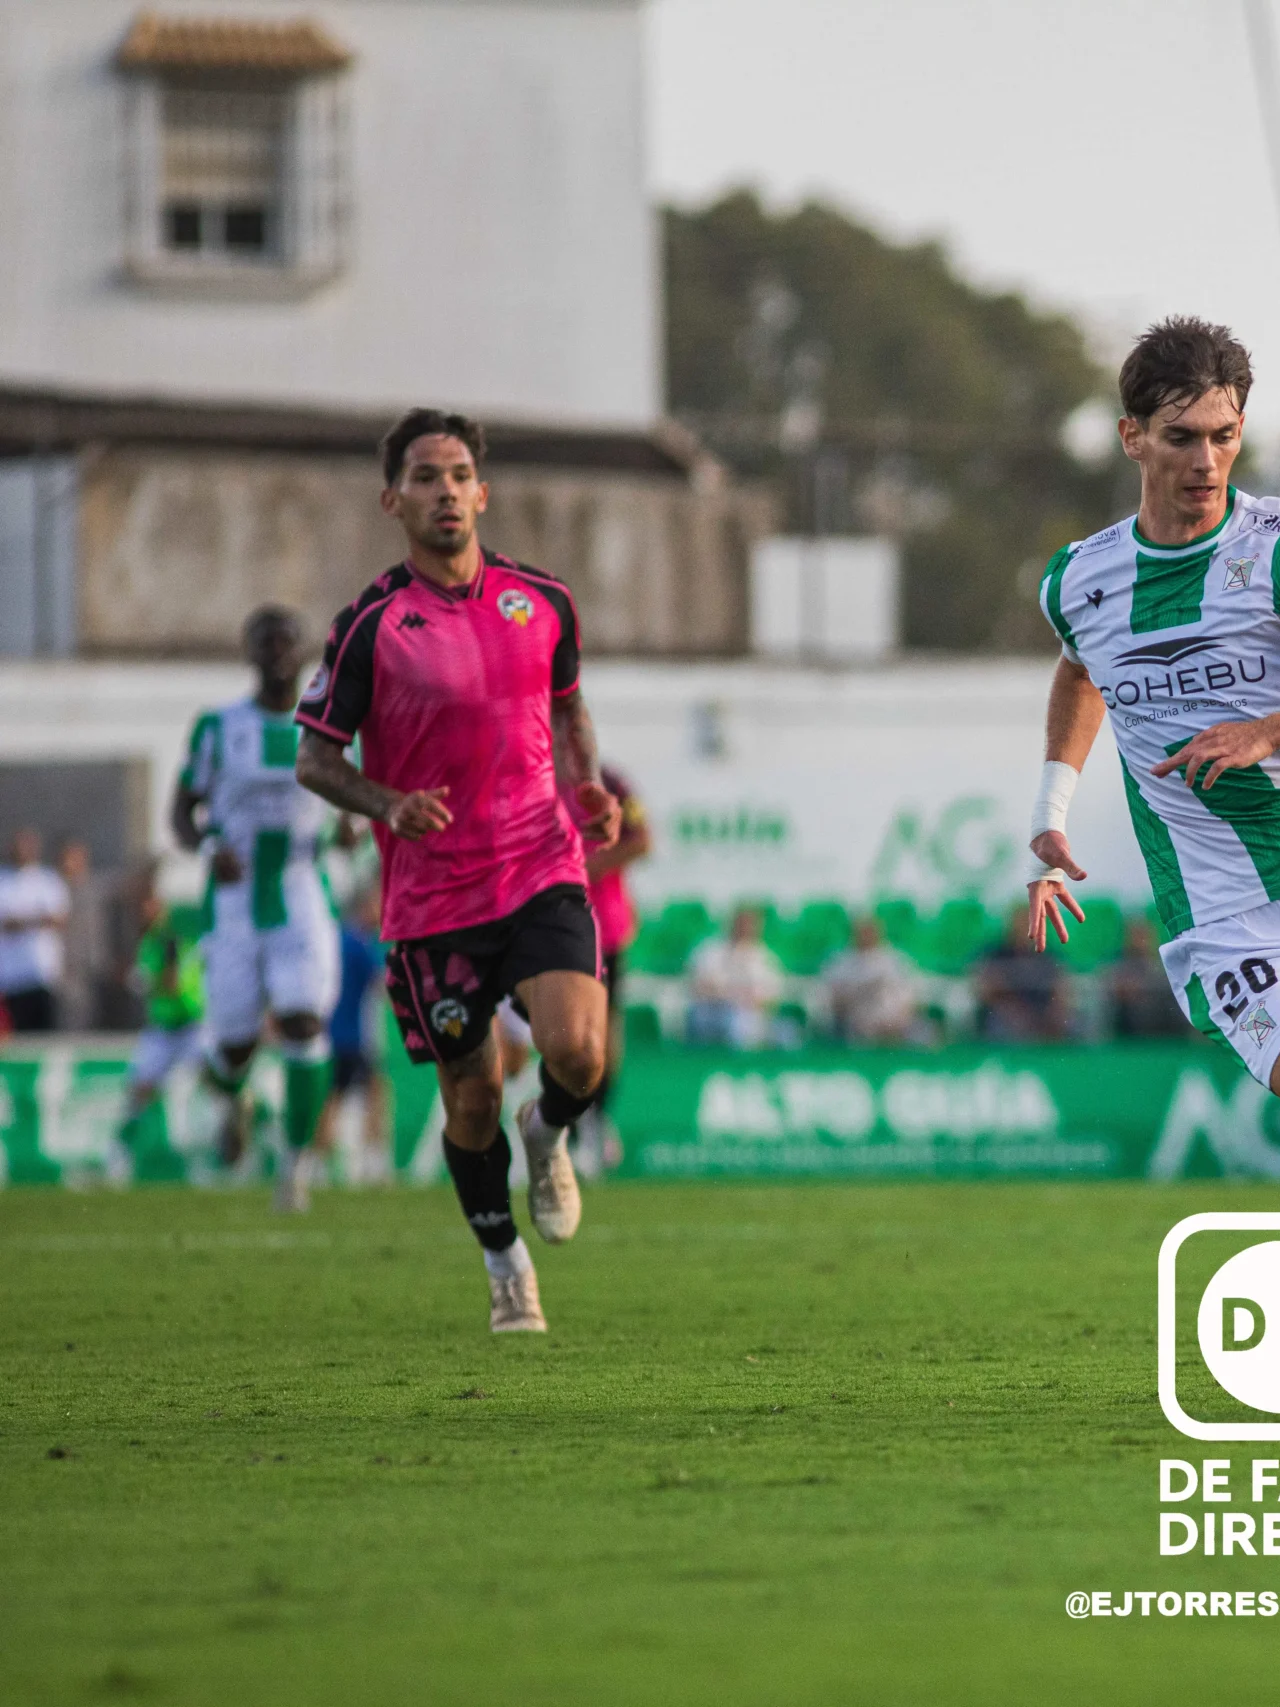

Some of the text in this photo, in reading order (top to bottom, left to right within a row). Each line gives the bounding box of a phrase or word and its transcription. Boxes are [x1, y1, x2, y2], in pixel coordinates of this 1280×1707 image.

[1099, 655, 1266, 710] COHEBU
[1124, 706, 1179, 728] Correduría
[1182, 701, 1198, 713] de
[1215, 957, 1278, 1024] 20
